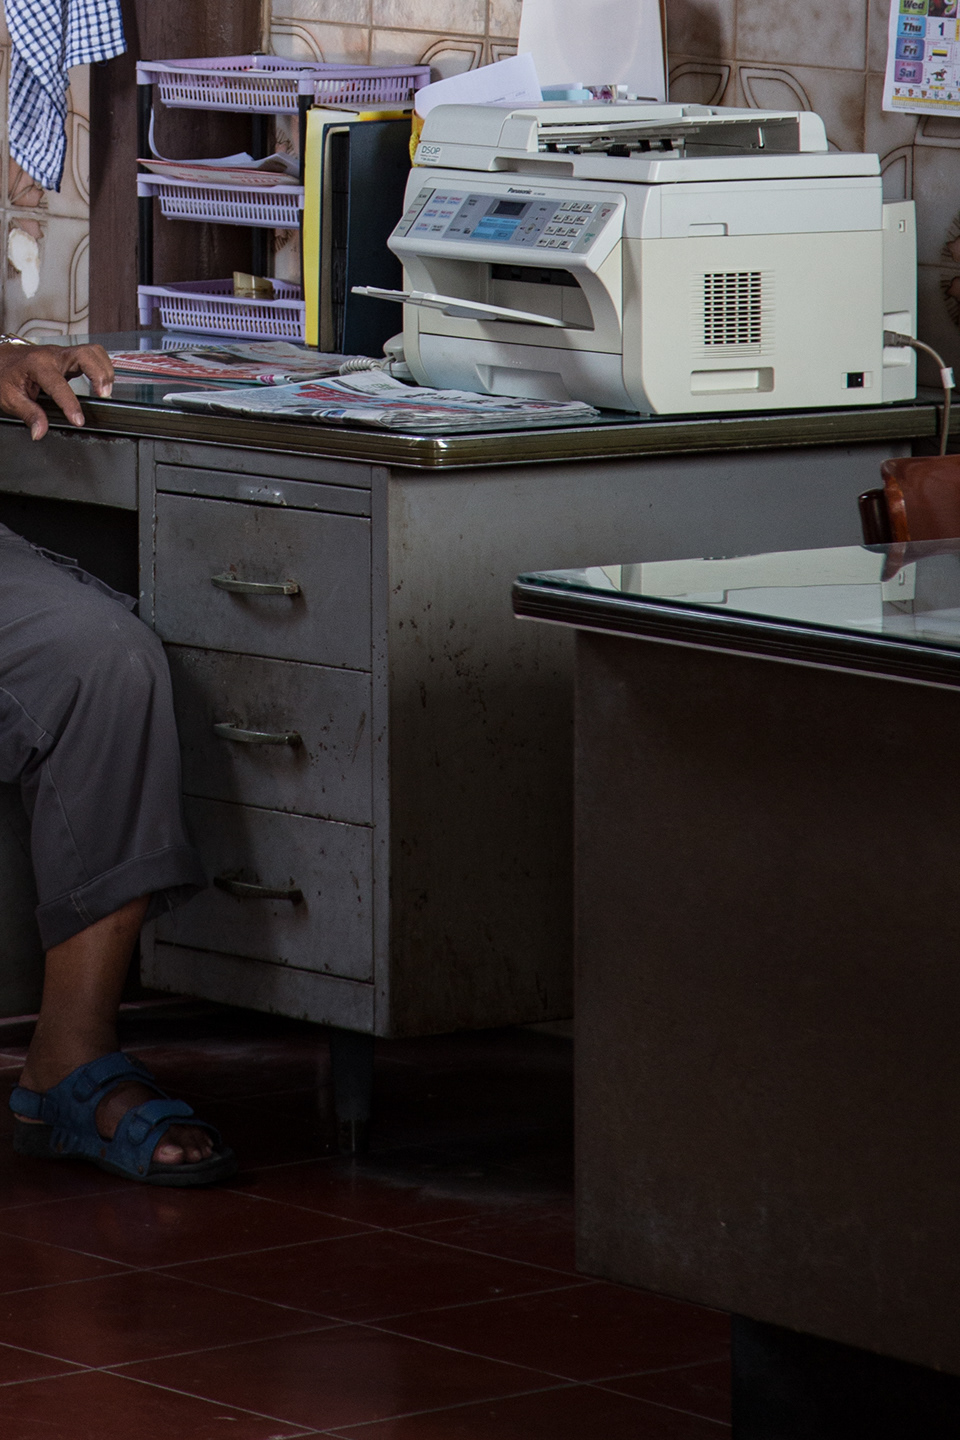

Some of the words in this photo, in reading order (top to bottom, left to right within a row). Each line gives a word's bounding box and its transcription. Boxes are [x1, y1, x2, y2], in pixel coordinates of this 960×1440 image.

[903, 0, 925, 10] Wed
[902, 22, 922, 33] Thu
[938, 22, 945, 36] 1
[903, 45, 918, 55] Fri
[899, 67, 916, 77] Sat
[507, 187, 533, 195] Panasonic
